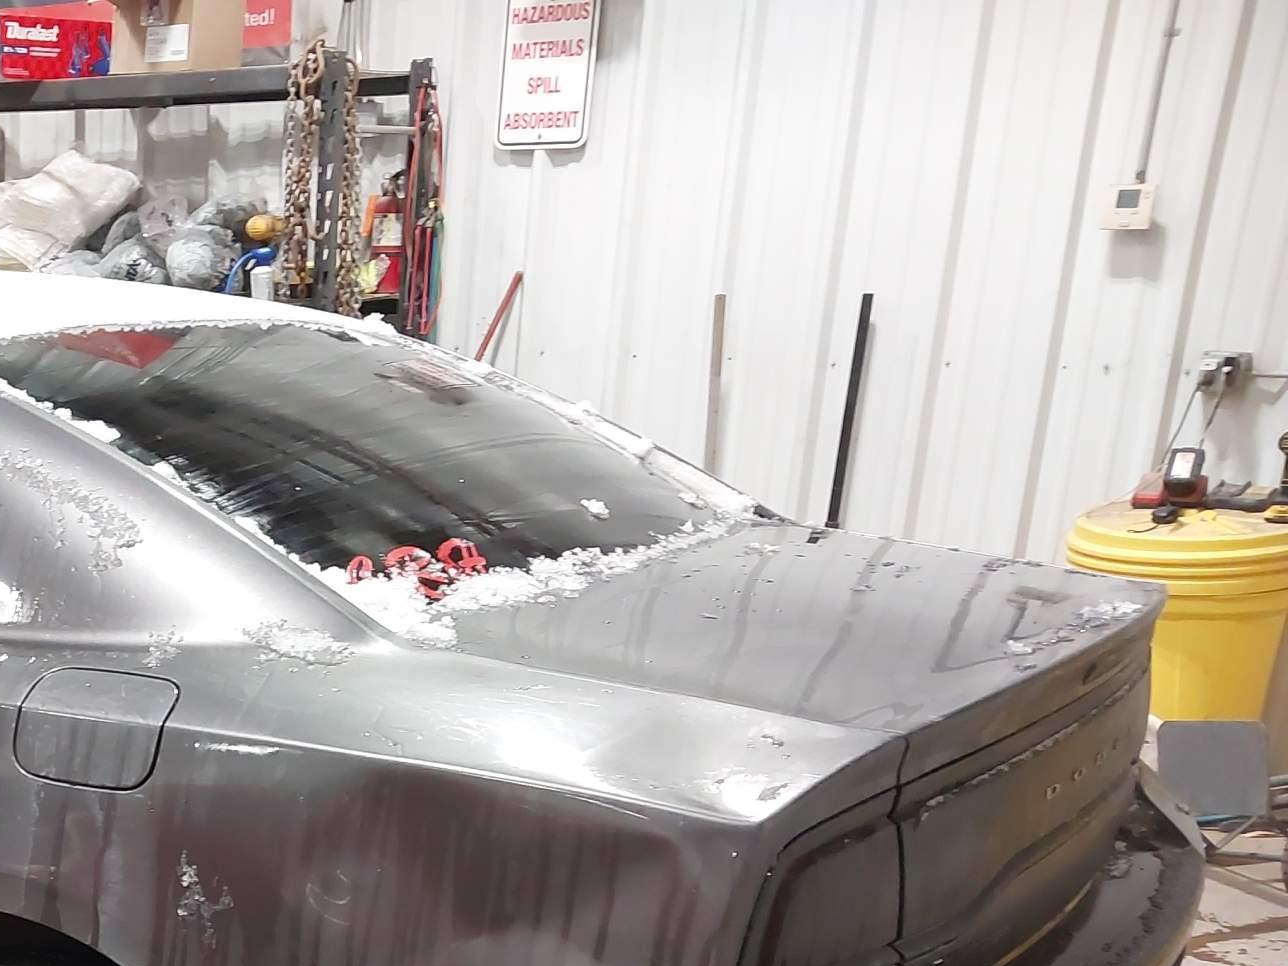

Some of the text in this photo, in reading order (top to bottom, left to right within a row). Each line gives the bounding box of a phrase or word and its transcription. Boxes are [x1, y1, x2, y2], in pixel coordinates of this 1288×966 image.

[511, 2, 591, 24] HAZARDOUS
[511, 38, 585, 60] MATERIALS
[527, 76, 561, 94] SPILL
[503, 110, 580, 130] ABSORBENT
